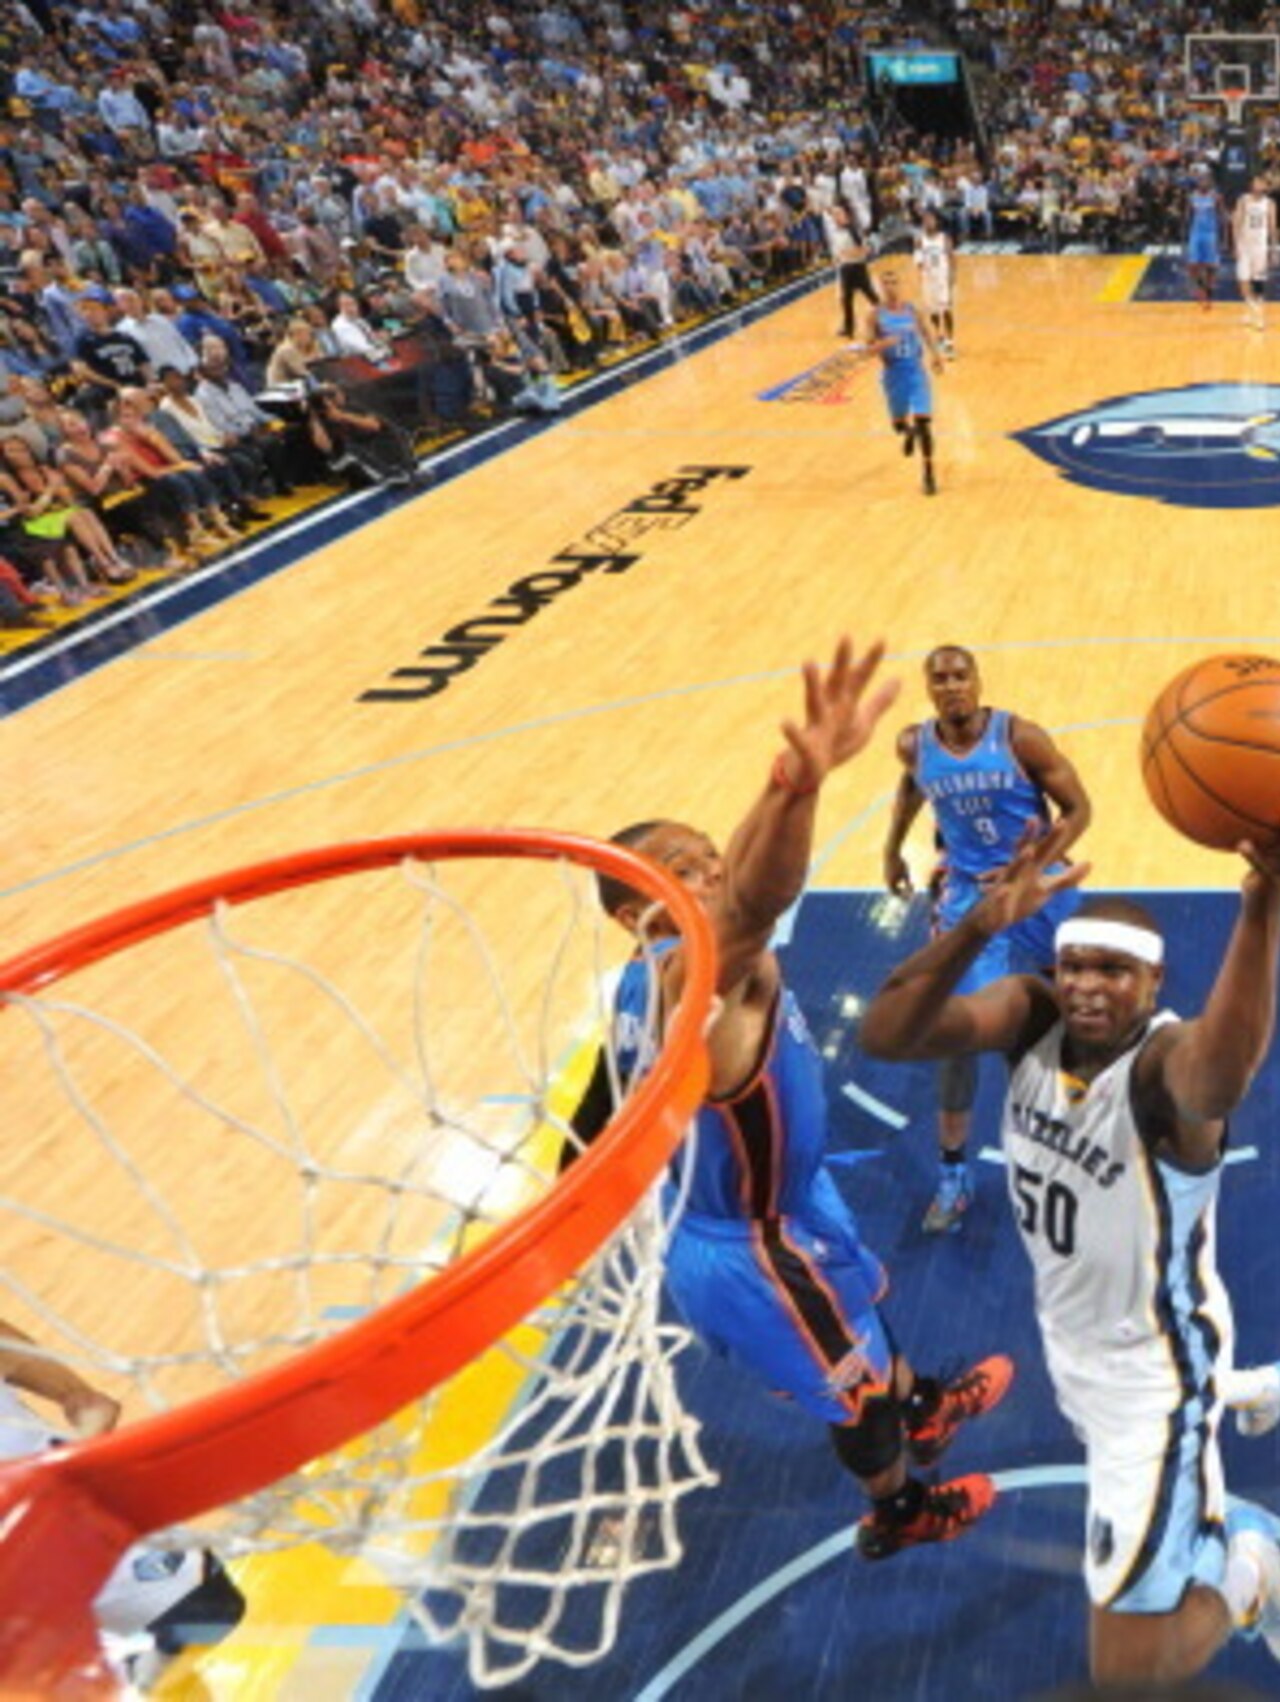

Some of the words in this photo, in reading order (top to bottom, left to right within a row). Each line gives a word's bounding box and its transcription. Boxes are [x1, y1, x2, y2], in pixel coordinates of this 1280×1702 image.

[975, 817, 1000, 845] 9
[1011, 1102, 1126, 1190] RIZZLIES
[1015, 1163, 1078, 1258] 50
